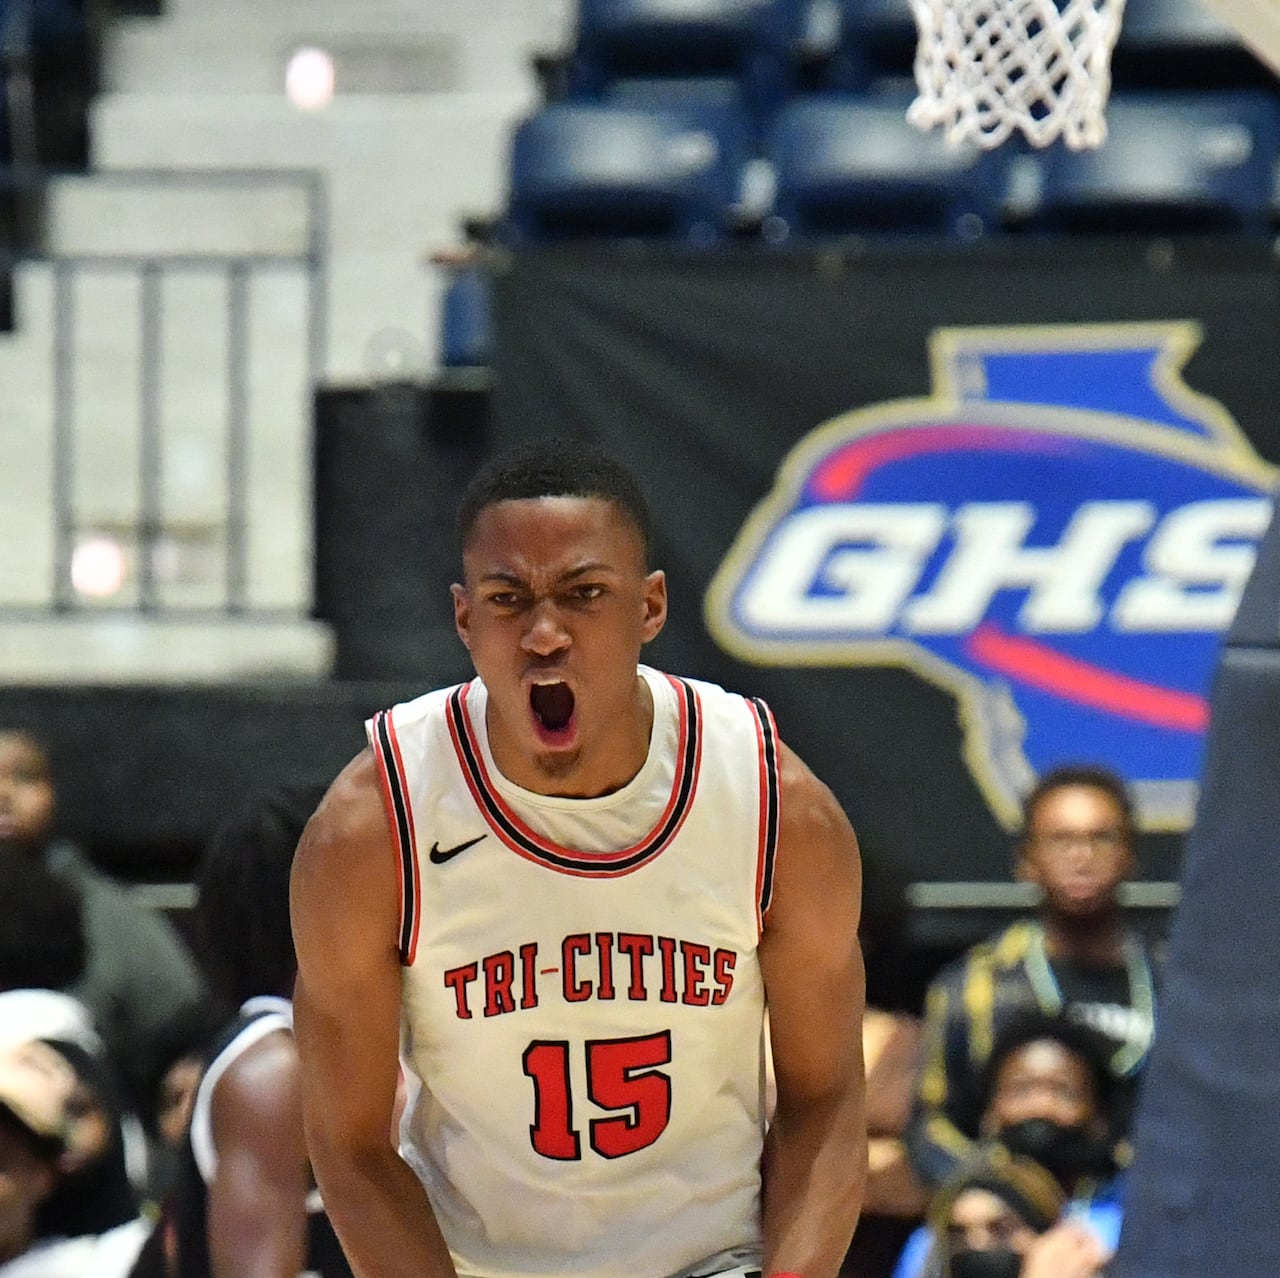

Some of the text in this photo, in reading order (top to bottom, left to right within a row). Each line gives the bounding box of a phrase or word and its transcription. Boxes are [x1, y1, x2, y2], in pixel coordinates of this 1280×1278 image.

[741, 499, 1274, 634] GHS
[444, 932, 737, 1020] TRI-CITIES
[522, 1029, 672, 1161] 15
